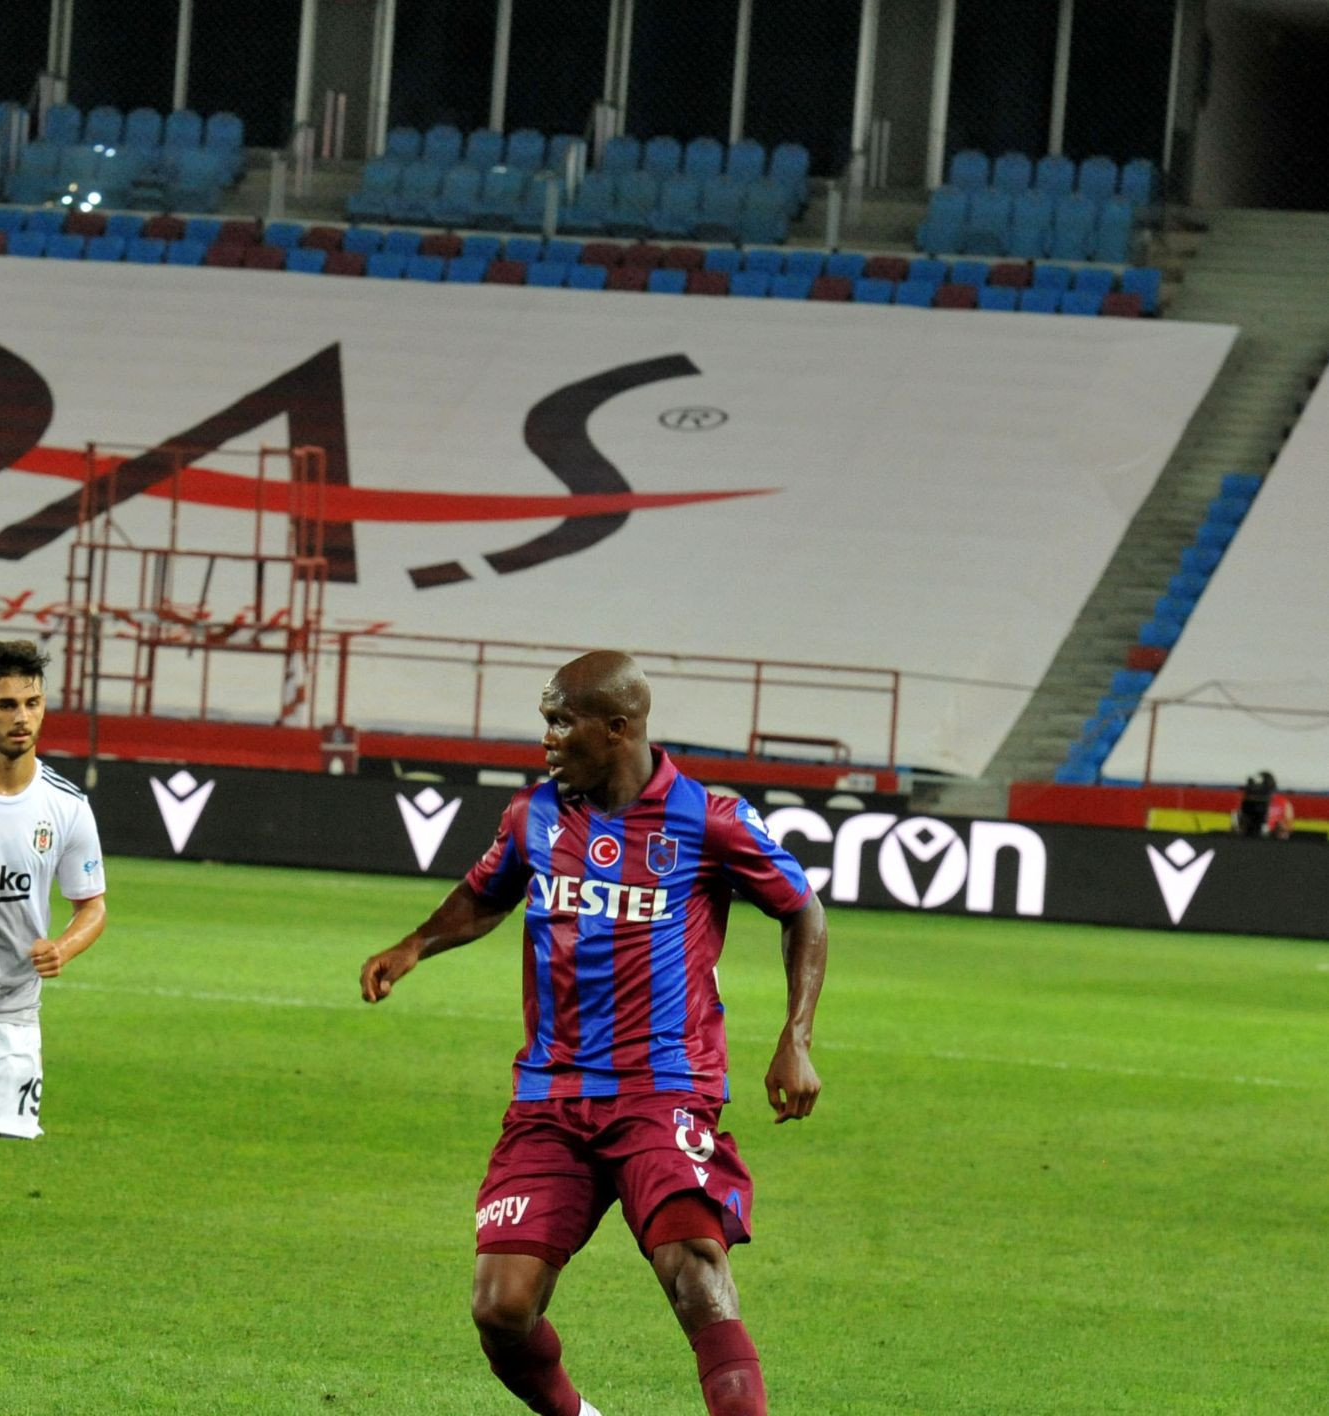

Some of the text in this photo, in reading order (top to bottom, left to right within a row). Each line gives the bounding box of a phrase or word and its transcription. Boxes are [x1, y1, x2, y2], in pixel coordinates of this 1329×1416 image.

[763, 806, 1047, 917] cron
[535, 871, 673, 923] VESTEL
[17, 1076, 44, 1117] 19
